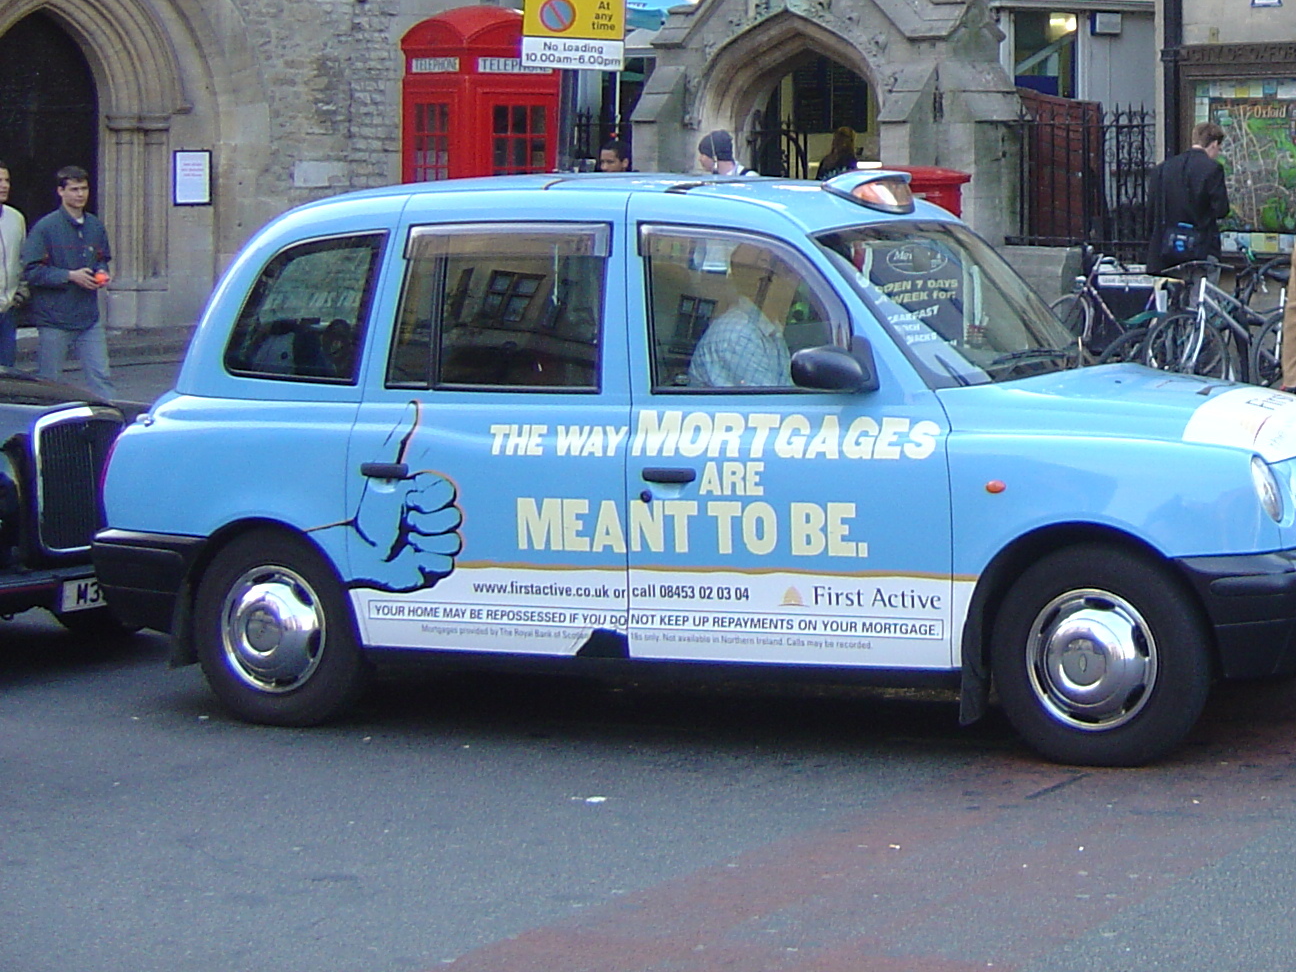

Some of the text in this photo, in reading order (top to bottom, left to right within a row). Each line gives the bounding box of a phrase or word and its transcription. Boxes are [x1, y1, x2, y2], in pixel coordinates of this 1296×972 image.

[598, 1, 610, 10] At
[594, 12, 613, 22] any
[592, 22, 616, 31] time
[543, 41, 558, 51] No
[525, 53, 621, 66] 10.00am-6.00pm
[1253, 104, 1287, 119] Oxford
[927, 278, 958, 288] DAYS
[490, 409, 941, 460] THE WAY MORTGAGES
[699, 460, 765, 496] ARE
[516, 497, 869, 558] MEANT TO BE.
[473, 580, 750, 601] www.firstactive.co.uk or call 08453 02 03 04
[811, 585, 942, 610] First Active
[374, 605, 940, 637] YOUR HOME MAY BE REPOSSESSED IF YOU DO NOT KEEP UP REPAYMENTS ON YOUR MORTGAGE.
[500, 626, 513, 636] The
[662, 634, 676, 643] Not
[721, 636, 755, 646] Northern
[786, 638, 805, 647] Calls
